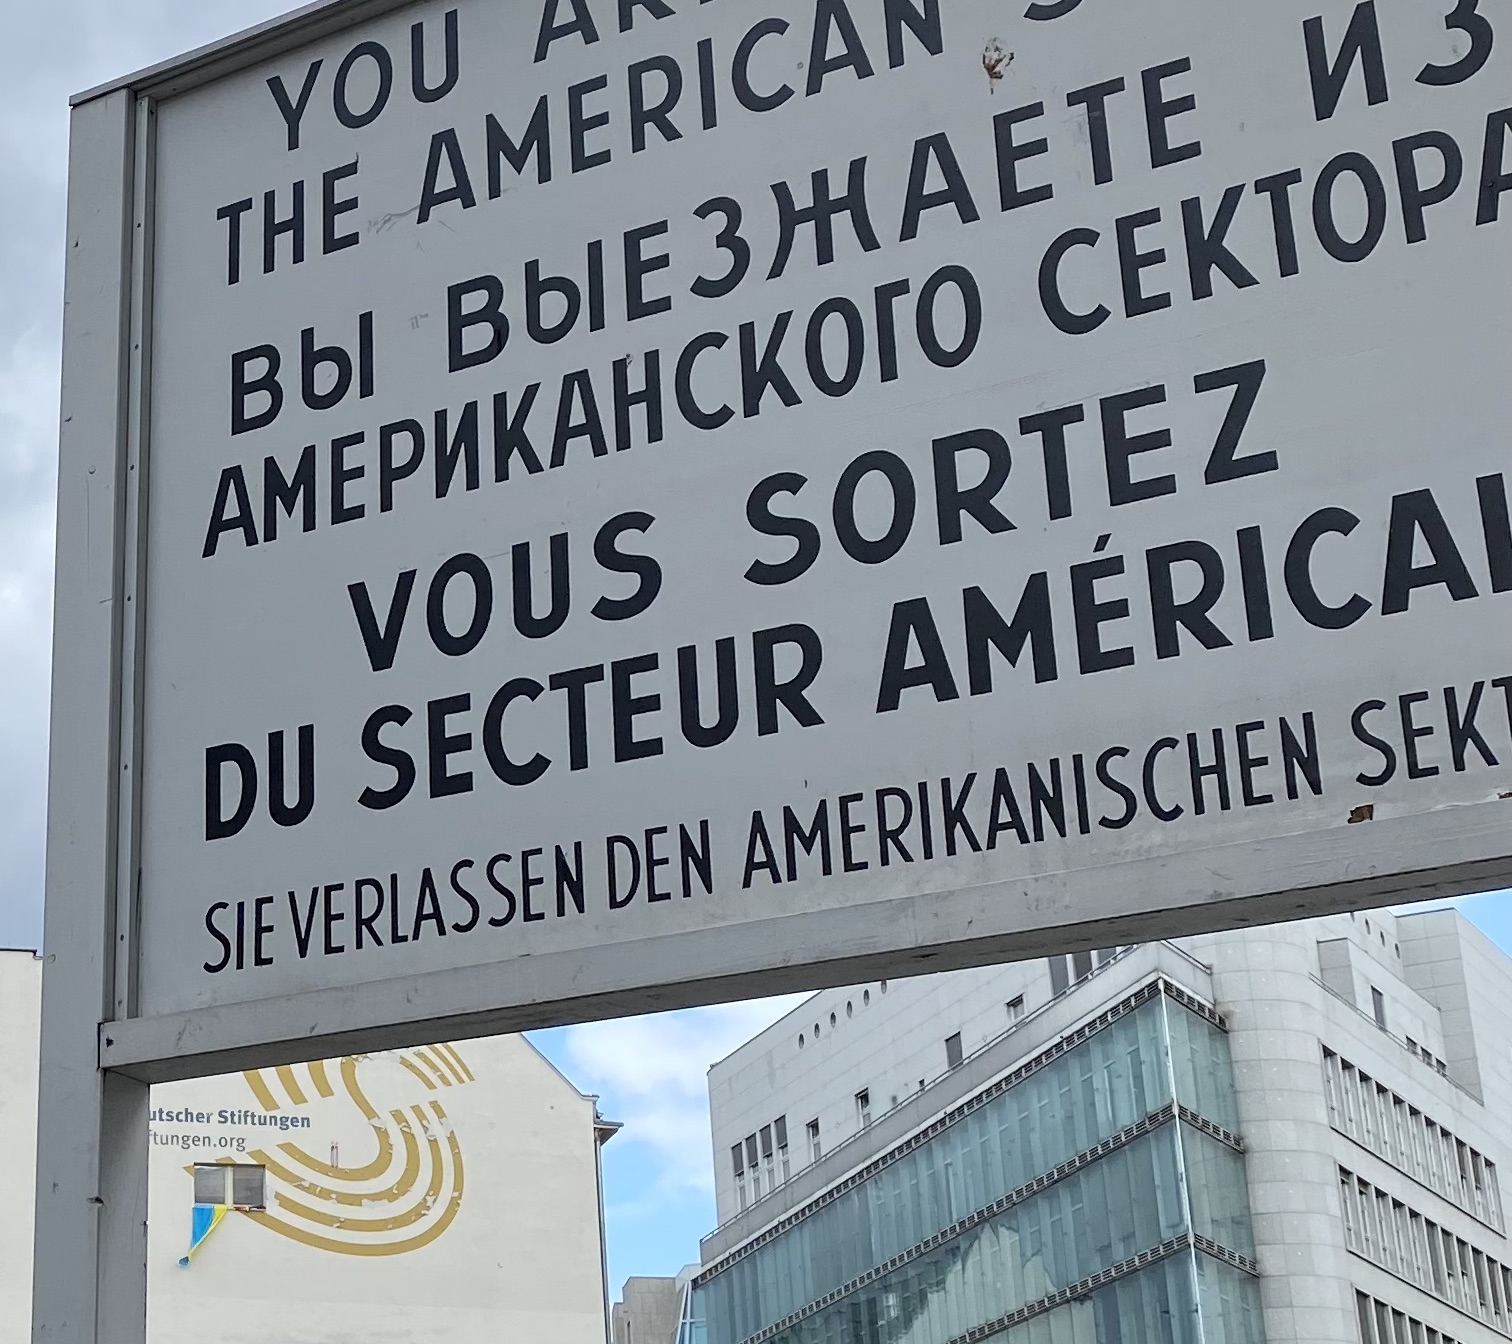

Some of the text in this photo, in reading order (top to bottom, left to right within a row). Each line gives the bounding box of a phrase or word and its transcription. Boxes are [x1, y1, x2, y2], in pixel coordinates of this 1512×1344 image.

[266, 9, 459, 151] YOU
[217, 153, 359, 285] THE
[231, 311, 374, 436] ВЫ
[447, 57, 1201, 373] ВЫЕЗЖАЕТЕ
[202, 265, 981, 558] АМЕРИКАНСКОГО
[347, 359, 1278, 672] VOUS SORTEZ
[206, 724, 314, 841] DU
[358, 624, 825, 810] SECTEUR
[607, 819, 712, 909] DEN
[742, 712, 1322, 889] AMERIKANISCHEN
[217, 1109, 311, 1131] Stiftungen
